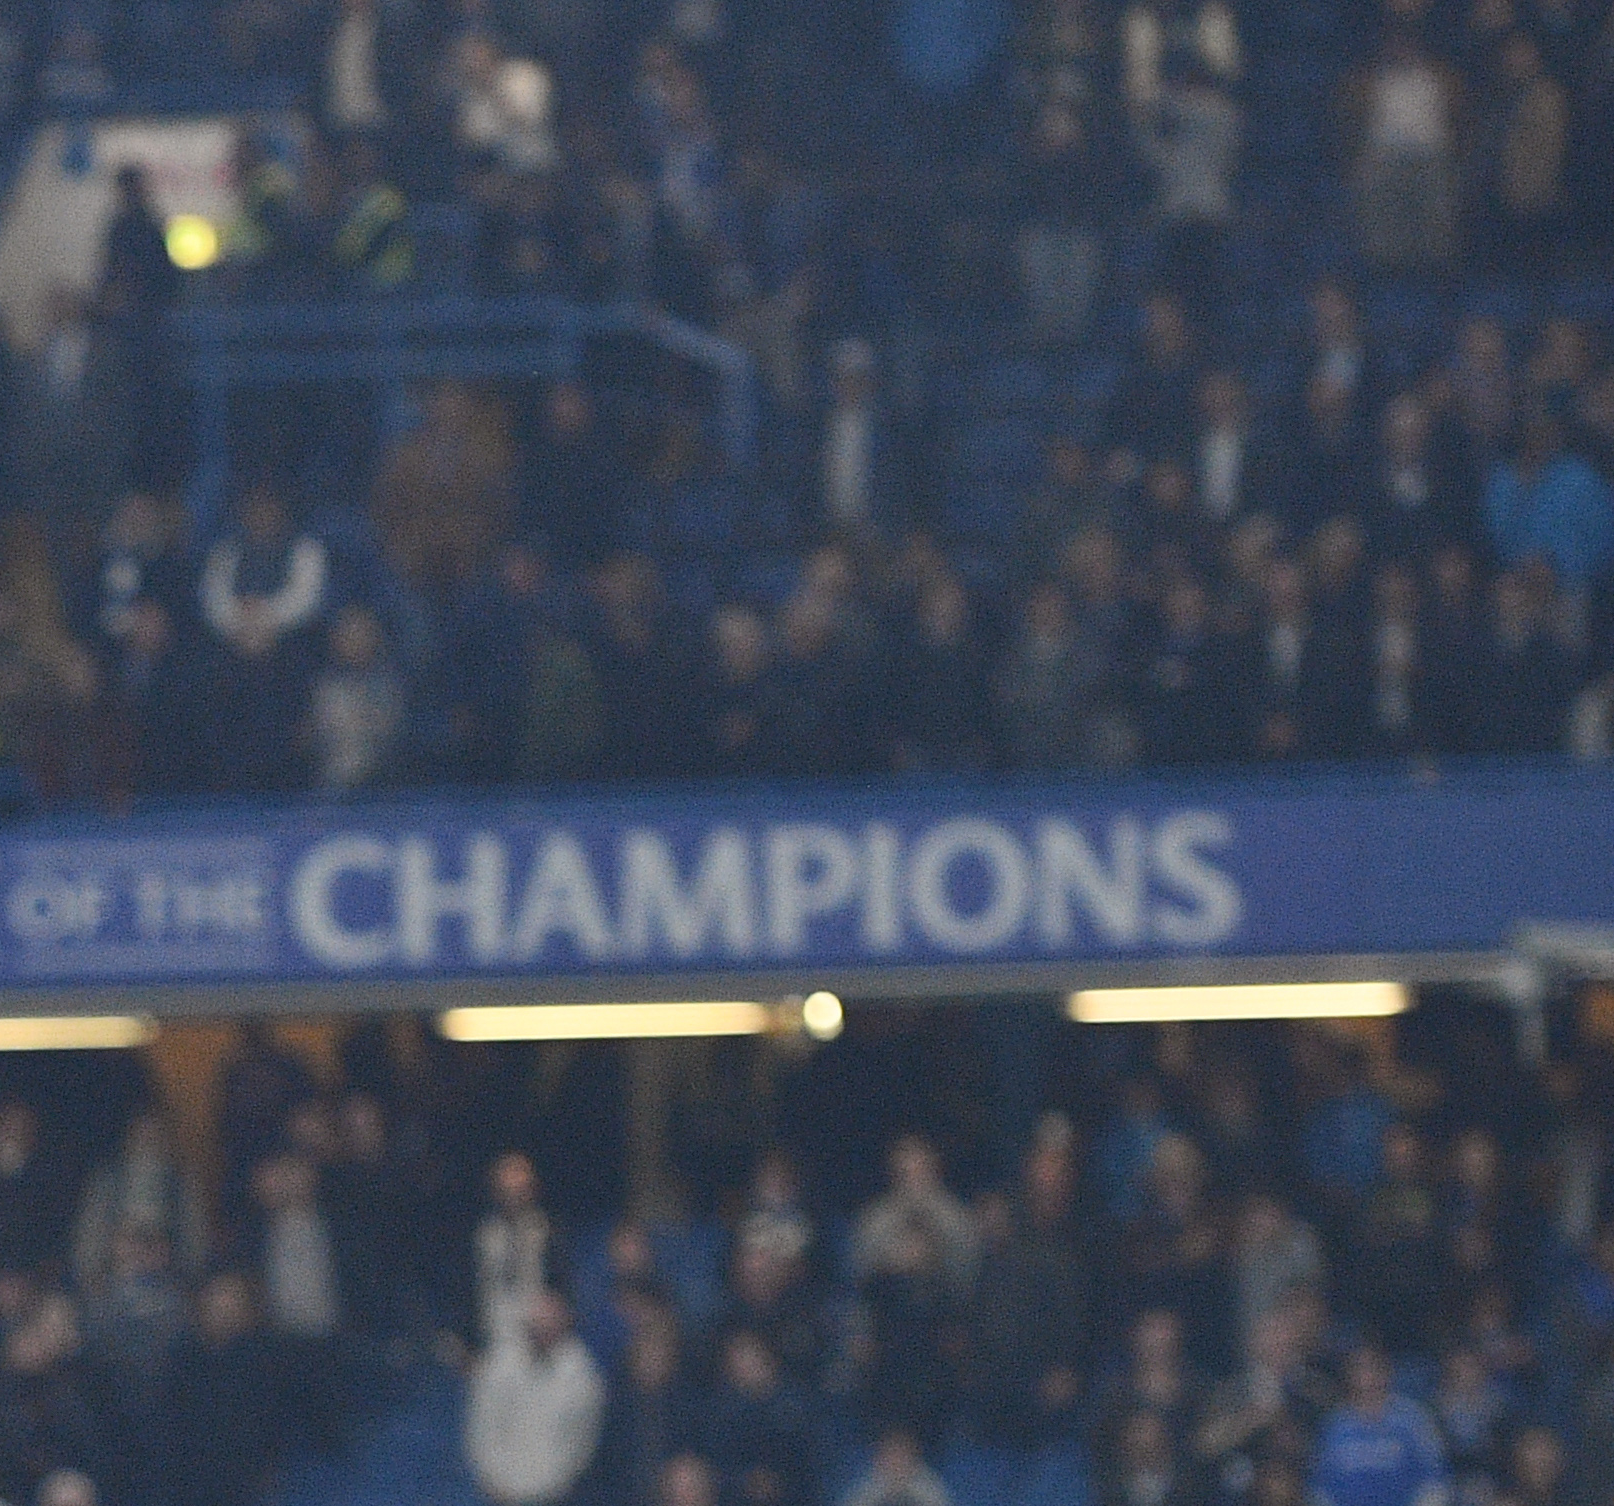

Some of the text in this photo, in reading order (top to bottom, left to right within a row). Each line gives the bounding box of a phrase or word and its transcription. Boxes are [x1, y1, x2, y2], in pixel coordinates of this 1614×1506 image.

[7, 872, 105, 940] OF
[132, 868, 264, 930] THE
[289, 811, 1245, 969] CHAMPIONS
